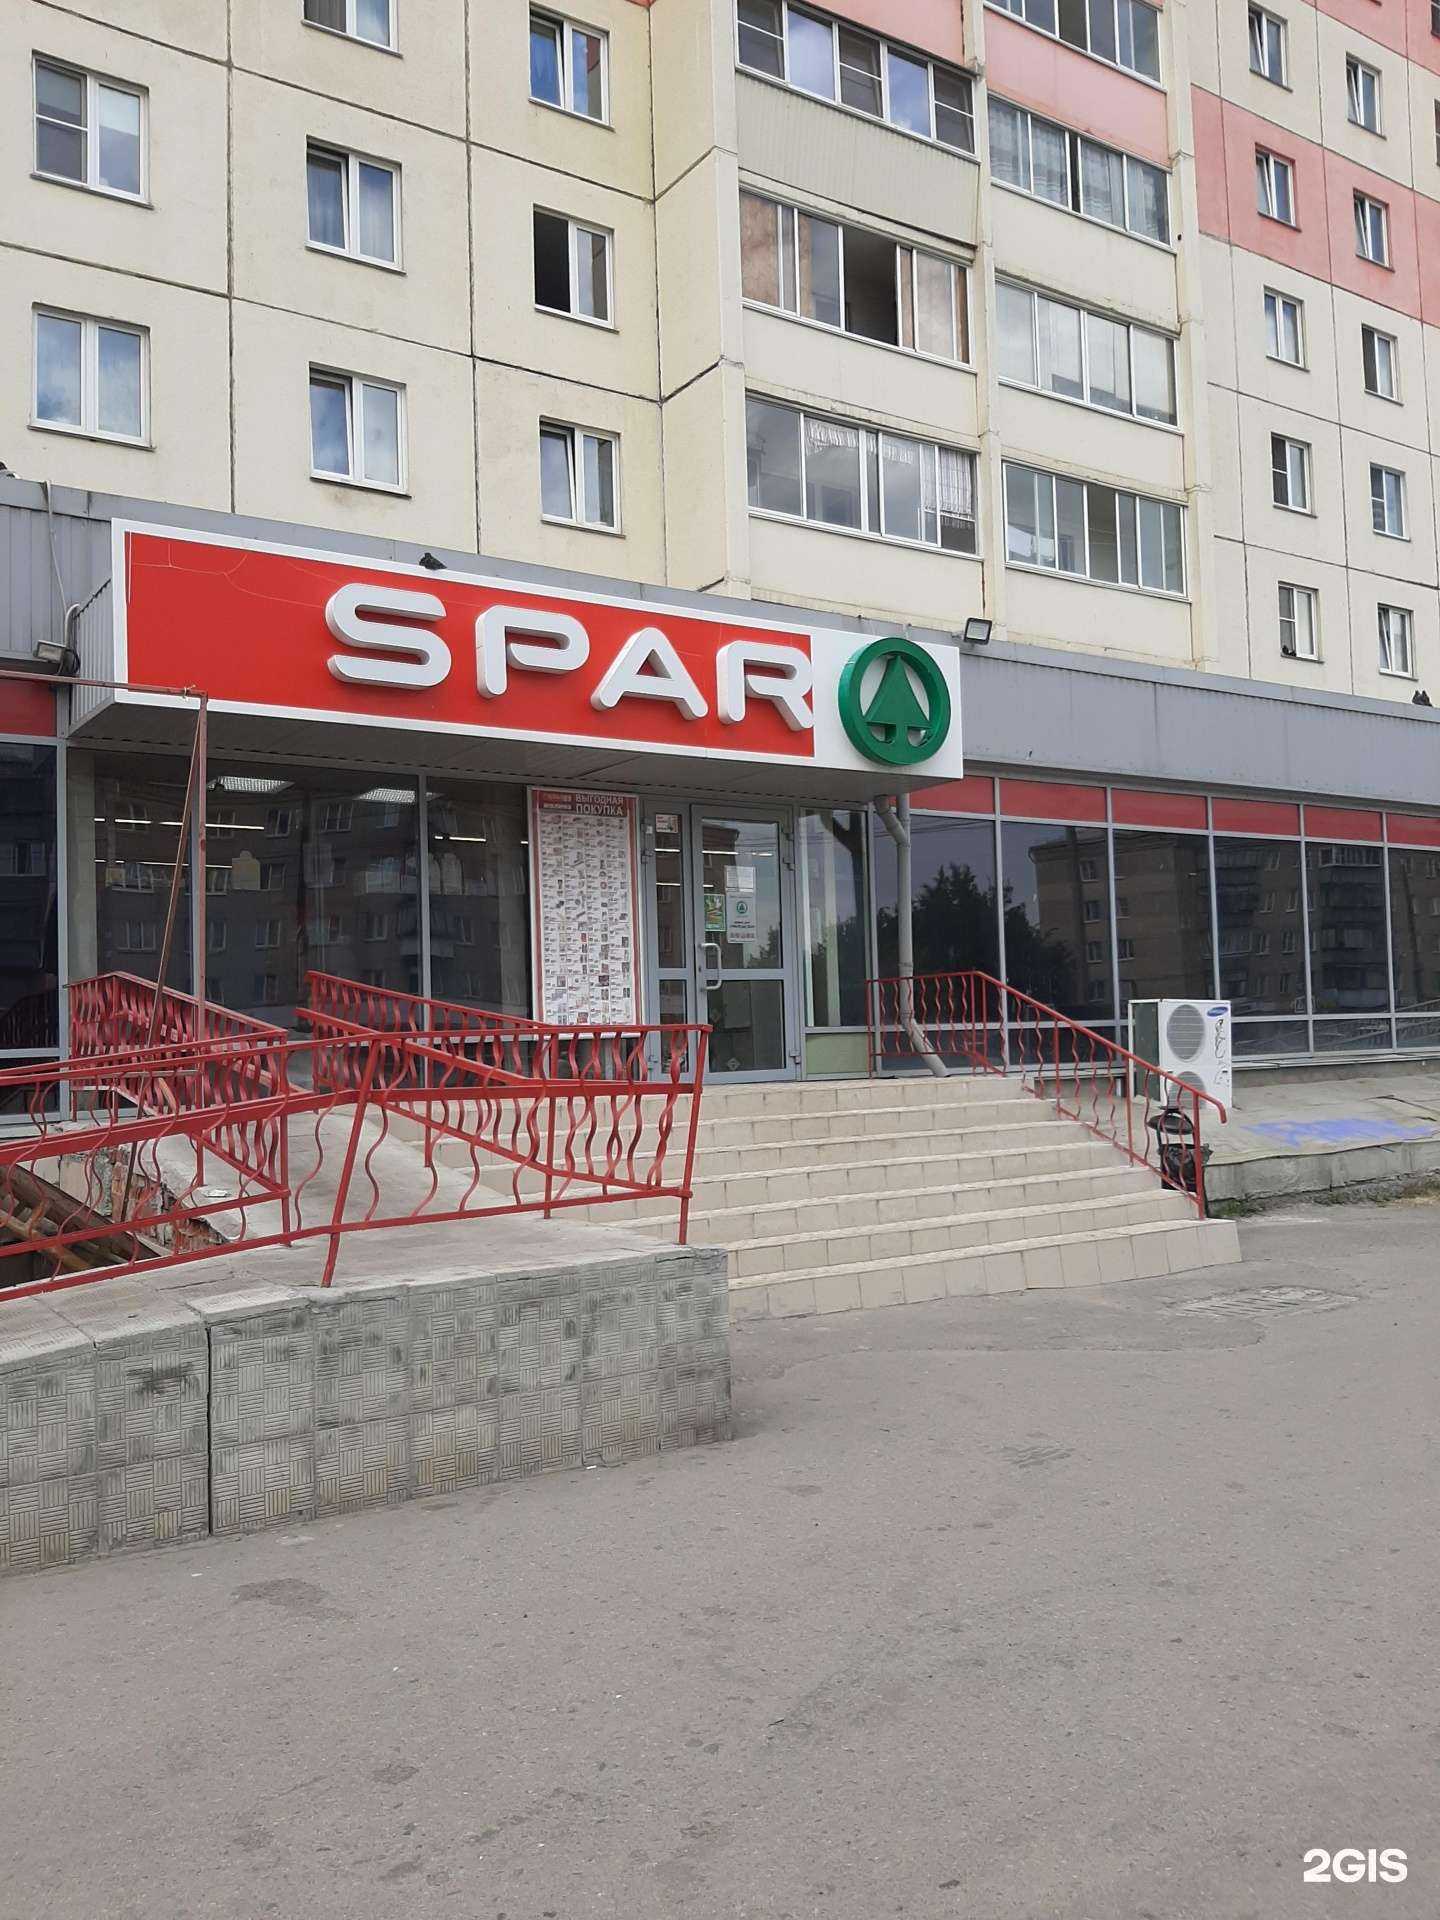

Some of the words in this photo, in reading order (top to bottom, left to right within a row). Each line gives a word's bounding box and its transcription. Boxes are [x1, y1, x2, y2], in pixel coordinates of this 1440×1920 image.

[325, 583, 815, 730] SPAR
[575, 793, 625, 805] ВЫГОДНАЯ
[575, 803, 625, 817] ПОКУПКА
